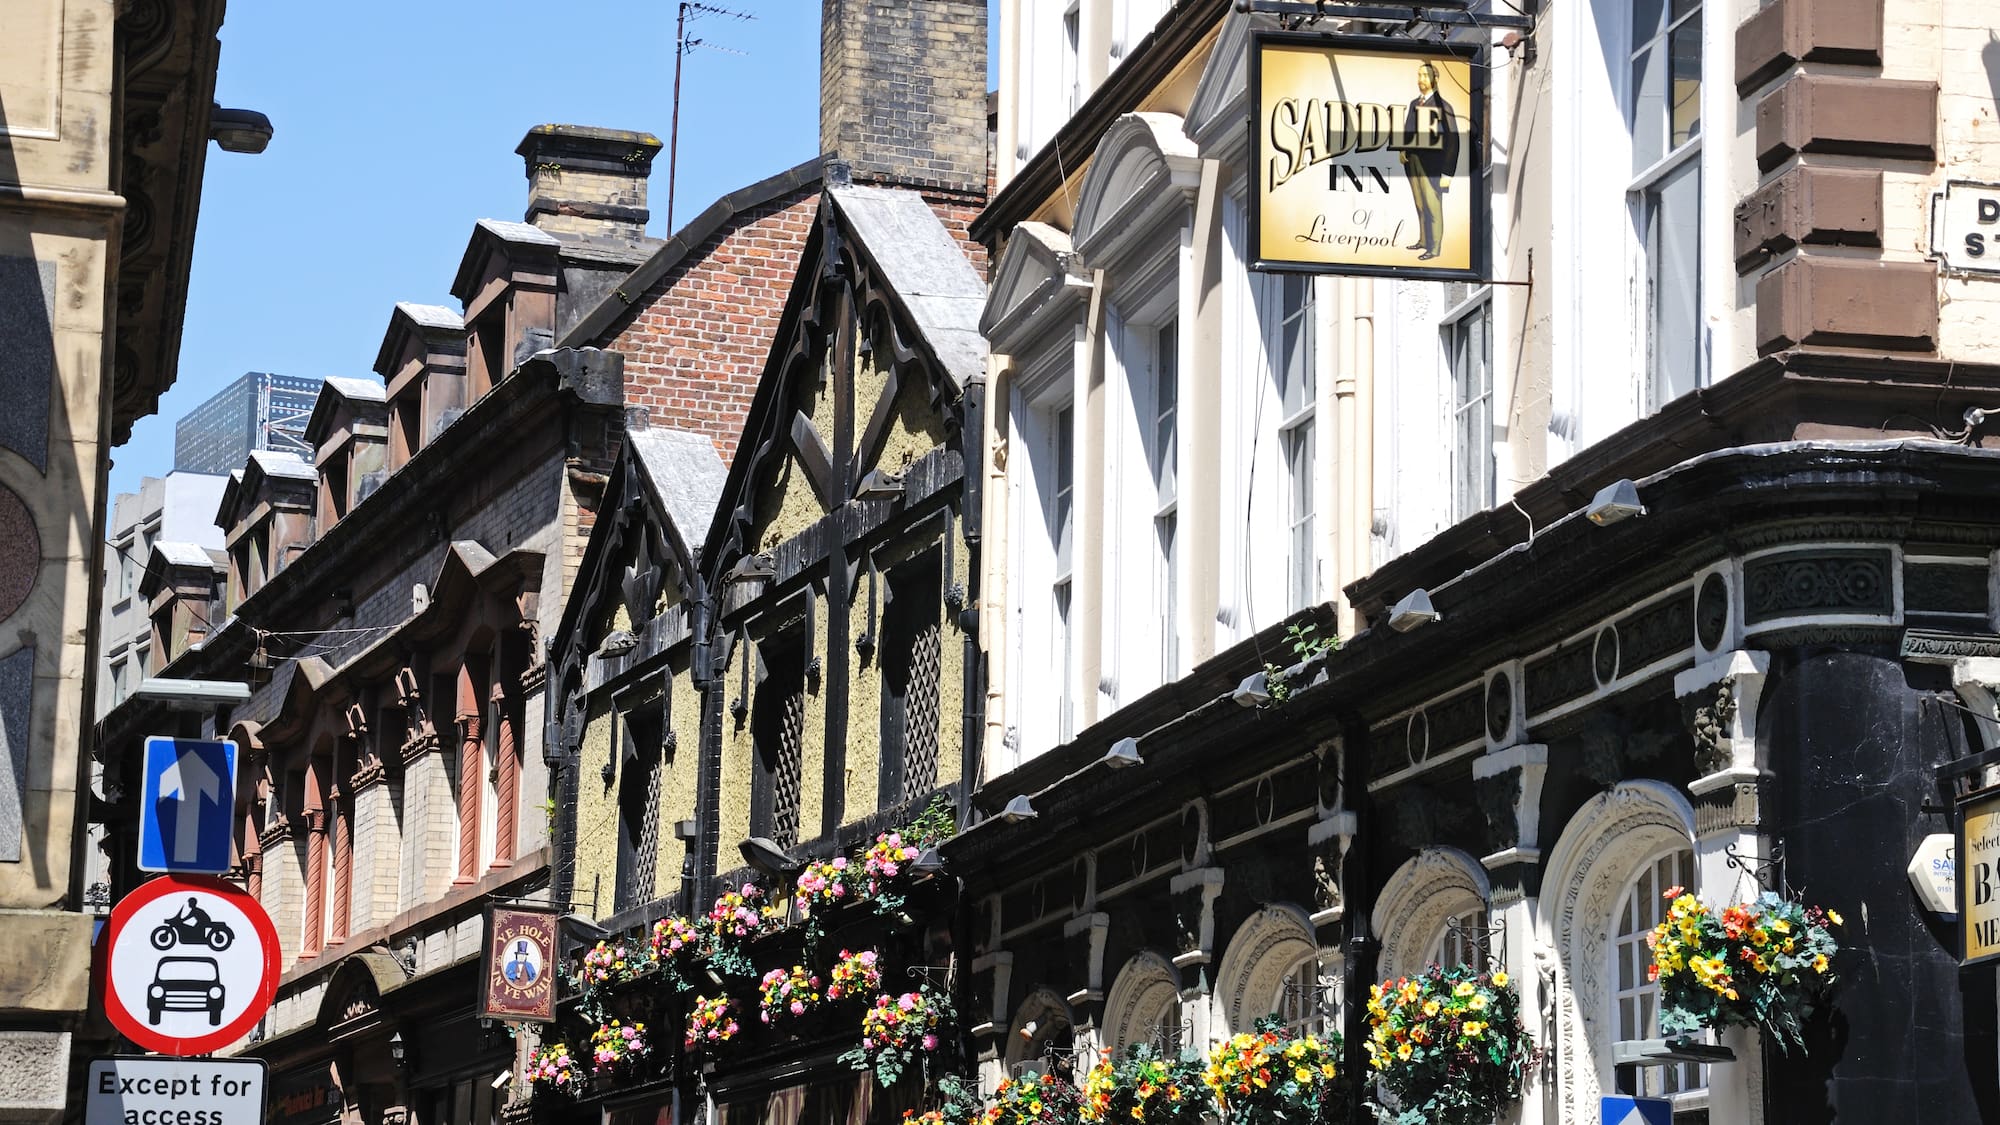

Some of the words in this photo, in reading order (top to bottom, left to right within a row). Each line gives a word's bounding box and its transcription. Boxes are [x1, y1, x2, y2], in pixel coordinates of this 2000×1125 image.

[1269, 97, 1443, 194] SADDLE
[1328, 164, 1392, 194] INN
[1352, 209, 1373, 229] Of
[1295, 214, 1404, 254] Liverpool
[1965, 232, 2000, 256] S
[496, 927, 515, 944] YE
[519, 925, 551, 947] HOLE
[1974, 917, 2000, 950] ME
[492, 970, 504, 987] IN
[504, 987, 521, 1000] YE
[523, 976, 553, 1000] WALL
[98, 1071, 201, 1100] Except
[211, 1074, 252, 1097] for
[124, 1108, 223, 1125] access
